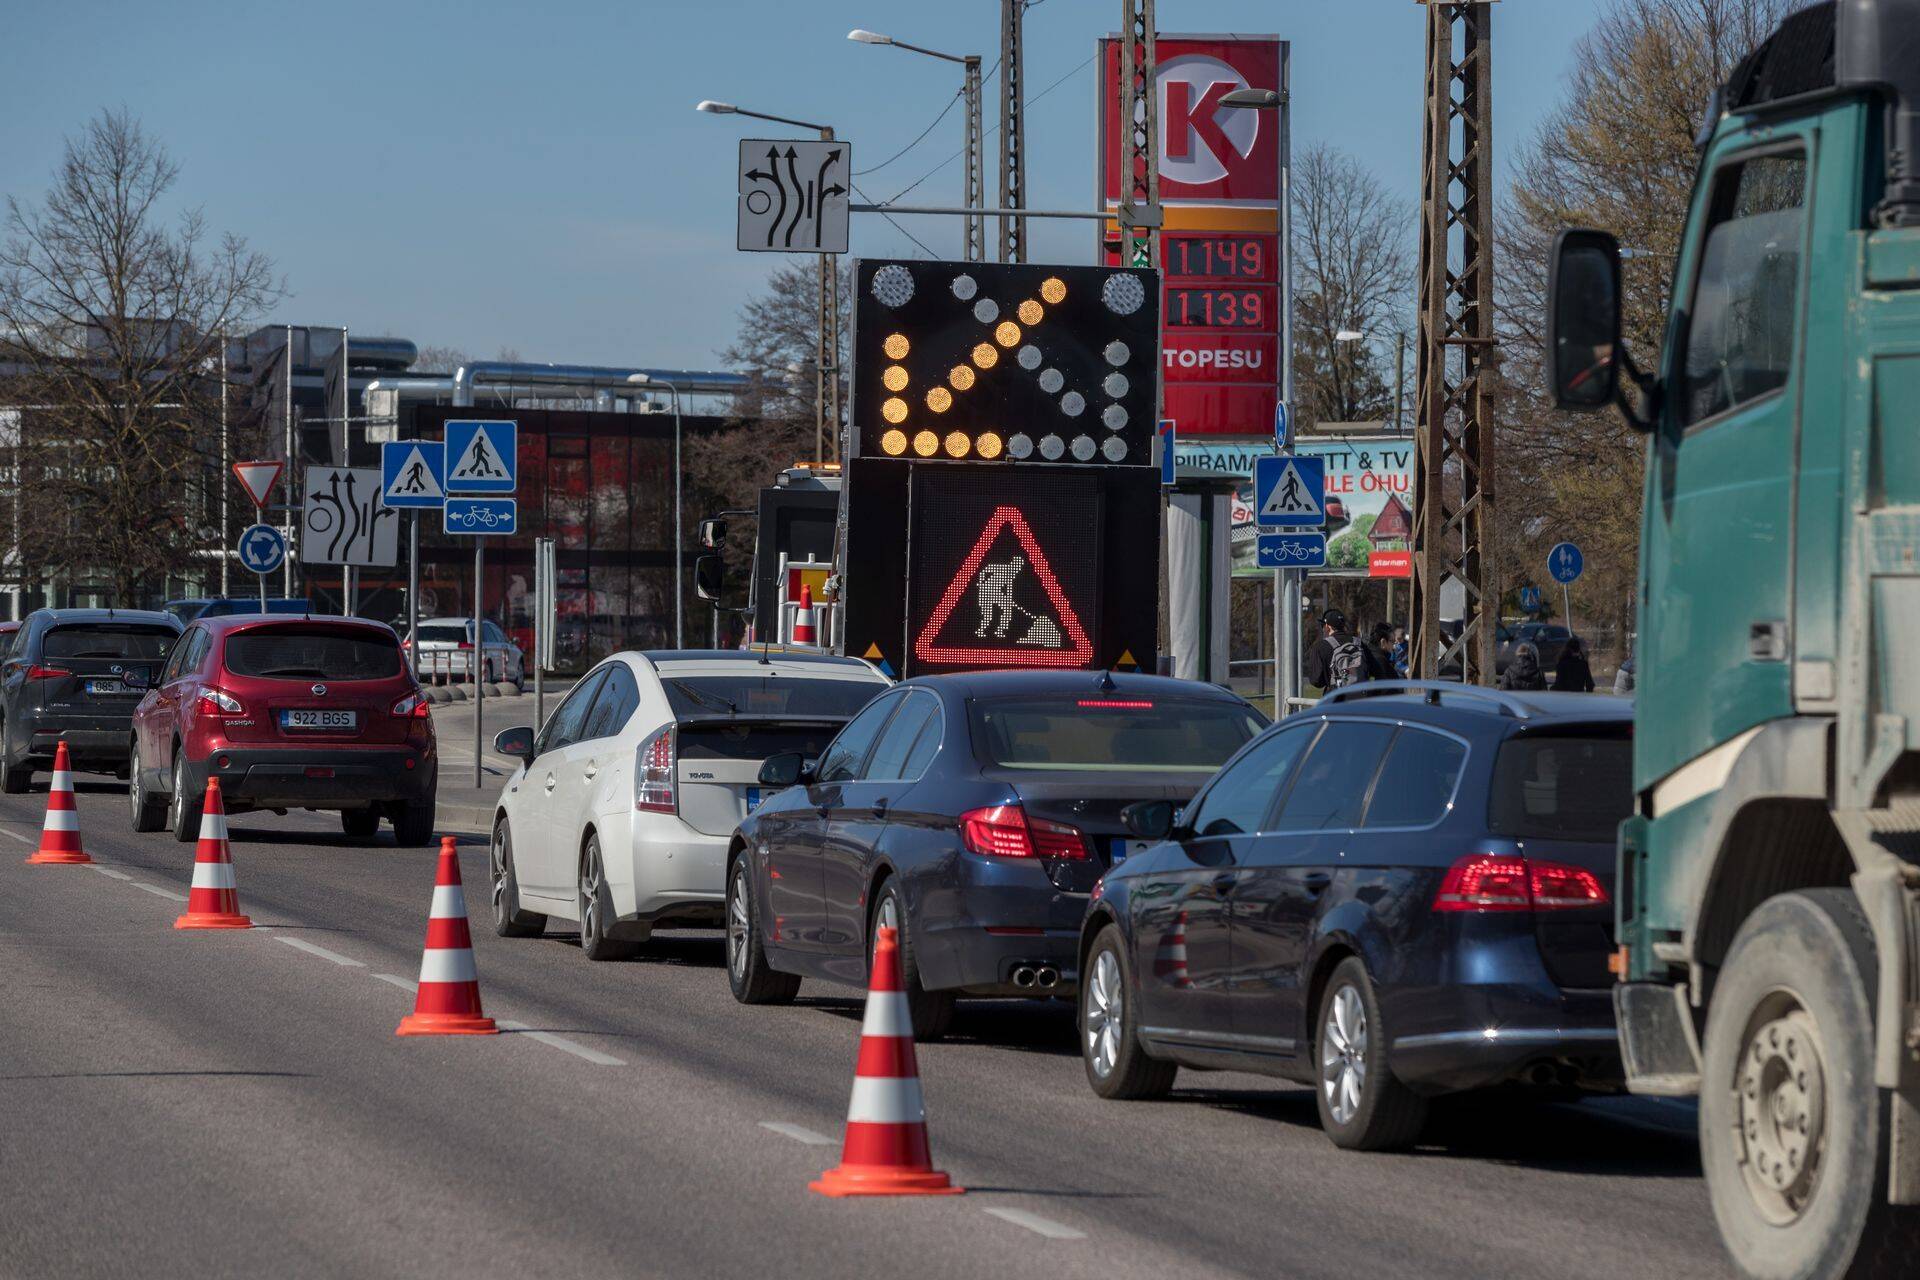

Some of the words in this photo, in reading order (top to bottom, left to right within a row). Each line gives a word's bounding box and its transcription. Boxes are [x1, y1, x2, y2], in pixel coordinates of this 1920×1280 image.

[1178, 241, 1261, 275] 1.149
[1178, 292, 1261, 325] 1.139
[1162, 349, 1262, 369] TOPESU
[1174, 453, 1257, 472] PIIRAM
[1358, 451, 1373, 470] &
[1379, 451, 1409, 469] TV
[1360, 471, 1409, 493] ÕHU
[293, 712, 318, 725] 922
[322, 712, 351, 725] BGS
